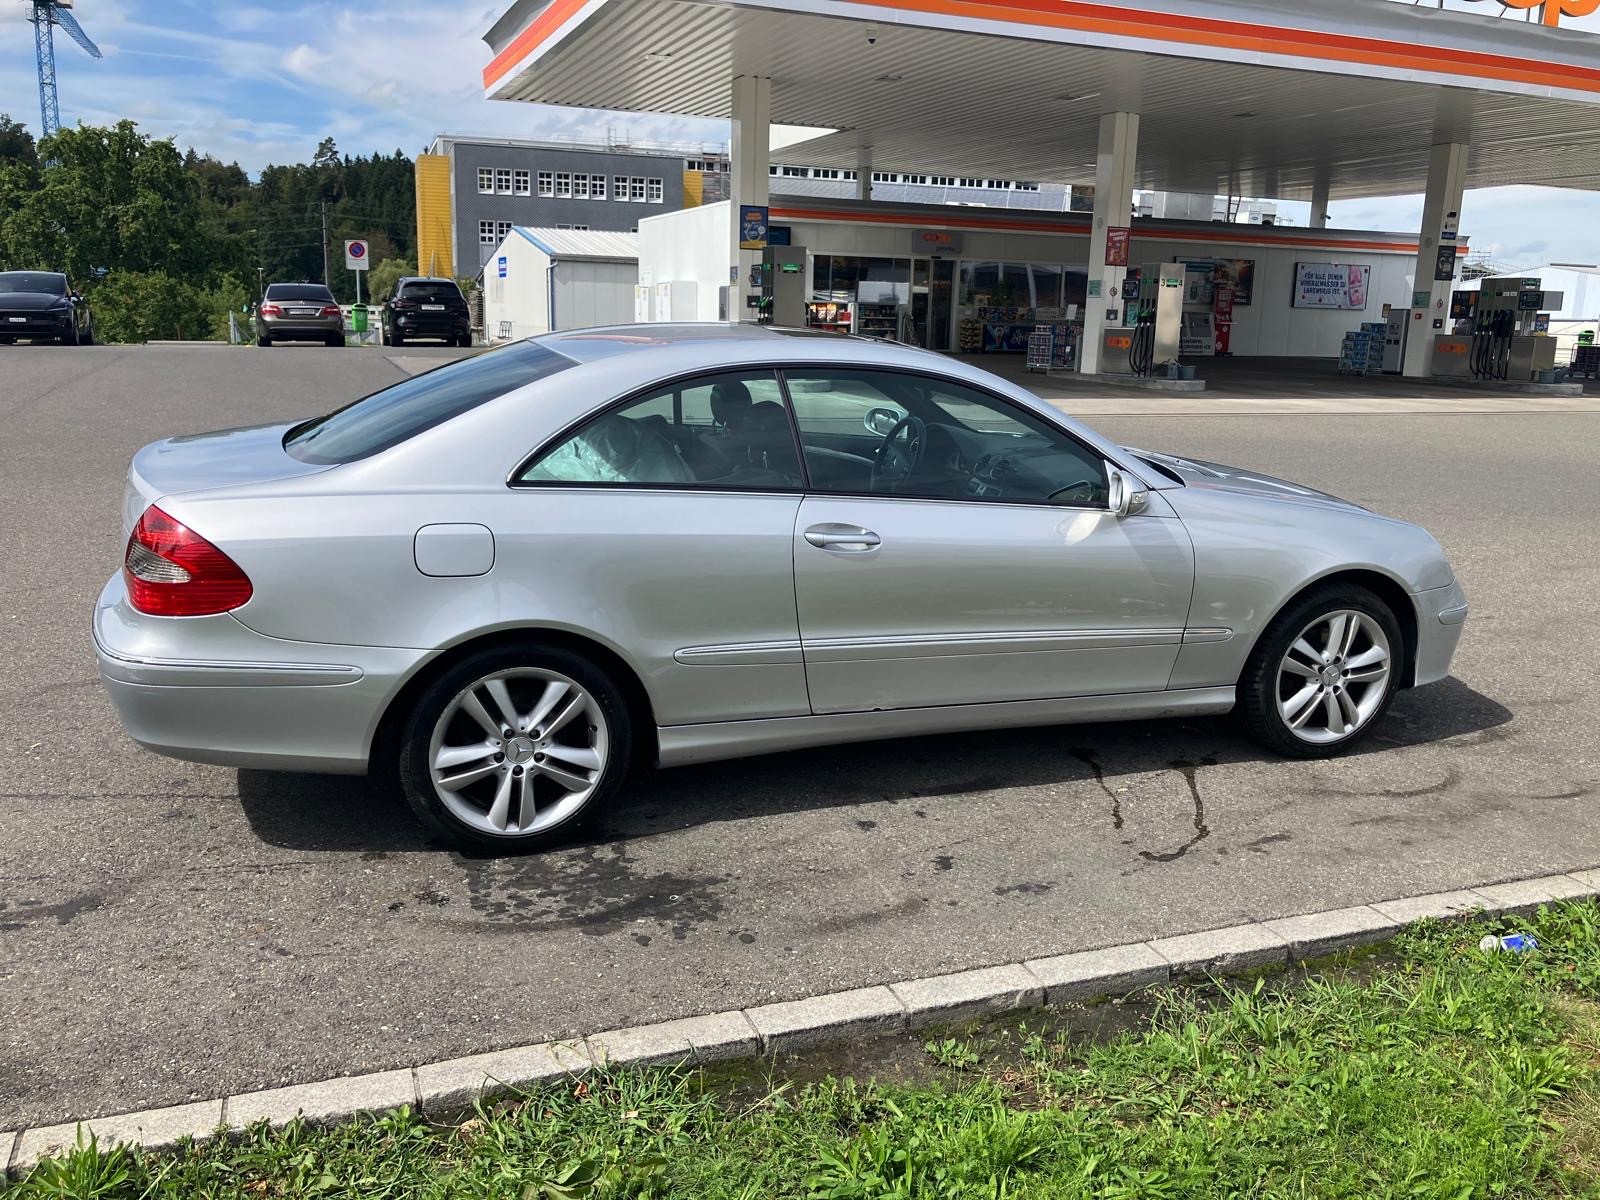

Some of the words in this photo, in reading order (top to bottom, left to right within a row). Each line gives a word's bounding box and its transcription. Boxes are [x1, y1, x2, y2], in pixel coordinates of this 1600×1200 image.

[799, 264, 804, 273] 2
[1304, 271, 1314, 280] FÜR
[1161, 279, 1166, 287] 3
